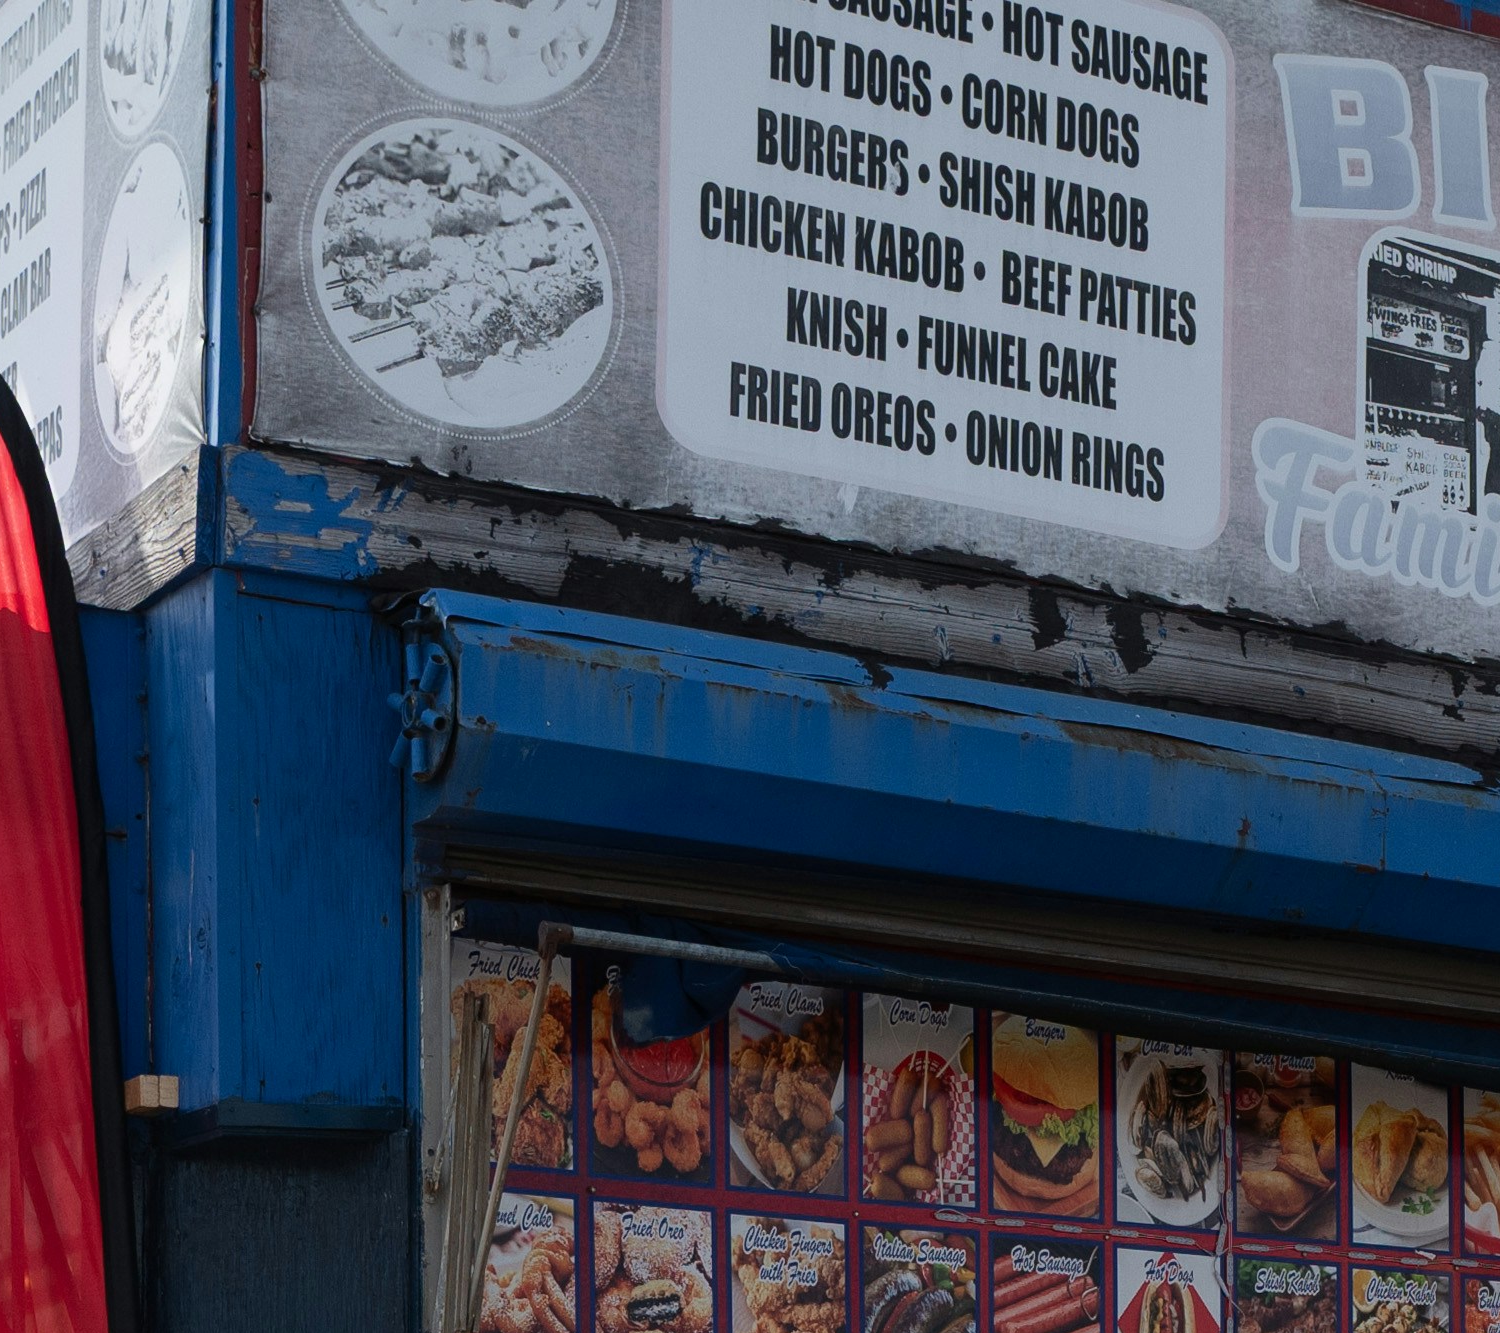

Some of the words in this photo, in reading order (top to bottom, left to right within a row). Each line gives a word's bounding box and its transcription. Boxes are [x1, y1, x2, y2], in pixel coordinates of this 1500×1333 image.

[1001, 0, 1062, 66] HOT
[1071, 19, 1209, 105] SAUSAGE
[3, 98, 31, 175] FRIED
[33, 48, 80, 143] CHICKEN
[770, 24, 834, 95] HOT
[843, 42, 932, 118] DOGS
[961, 74, 1049, 148] CORN
[1056, 101, 1140, 169] DOGS
[757, 108, 910, 198] BURGERS
[939, 151, 1035, 227] SHISH
[1043, 178, 1150, 253] KABOB
[19, 167, 47, 243] PIZZA
[699, 180, 846, 266] CHICKEN
[854, 217, 965, 294] KABOB
[1001, 249, 1071, 315] BEEF
[1077, 271, 1197, 346] PATTIES
[1405, 252, 1457, 284] SHRIMP
[0, 266, 27, 339] CLAM
[30, 247, 51, 315] BAR
[786, 287, 888, 362] KNISH
[918, 316, 1031, 394] FUNNEL
[1038, 345, 1117, 411] CAKE
[729, 361, 820, 434] FRIED
[831, 381, 937, 456] OREOS
[965, 410, 1063, 484] ONION
[1071, 432, 1165, 503] RINGS
[468, 950, 502, 977] Fried
[750, 985, 782, 1011] Fried
[786, 990, 823, 1017] Clams
[890, 1000, 916, 1025] Corn
[918, 1003, 948, 1028] Dogs
[1025, 1017, 1066, 1043] Burgers
[521, 1204, 553, 1230] Cake
[622, 1215, 655, 1240] Fried
[657, 1219, 685, 1240] Oreo
[744, 1226, 785, 1254] Chicken
[788, 1231, 833, 1259] Fingers
[874, 1234, 909, 1262] Italian
[912, 1241, 966, 1268] Sausage
[760, 1266, 784, 1283] with
[787, 1266, 817, 1287] Fries
[1011, 1245, 1035, 1271] Hot
[1038, 1250, 1084, 1277] Sausage
[1145, 1259, 1165, 1283] Hot
[1167, 1262, 1195, 1285] Dogs
[1256, 1270, 1282, 1295] Shish
[1284, 1272, 1320, 1296] Kabob
[1366, 1277, 1398, 1304] Chicken
[1401, 1282, 1436, 1306] Kabob
